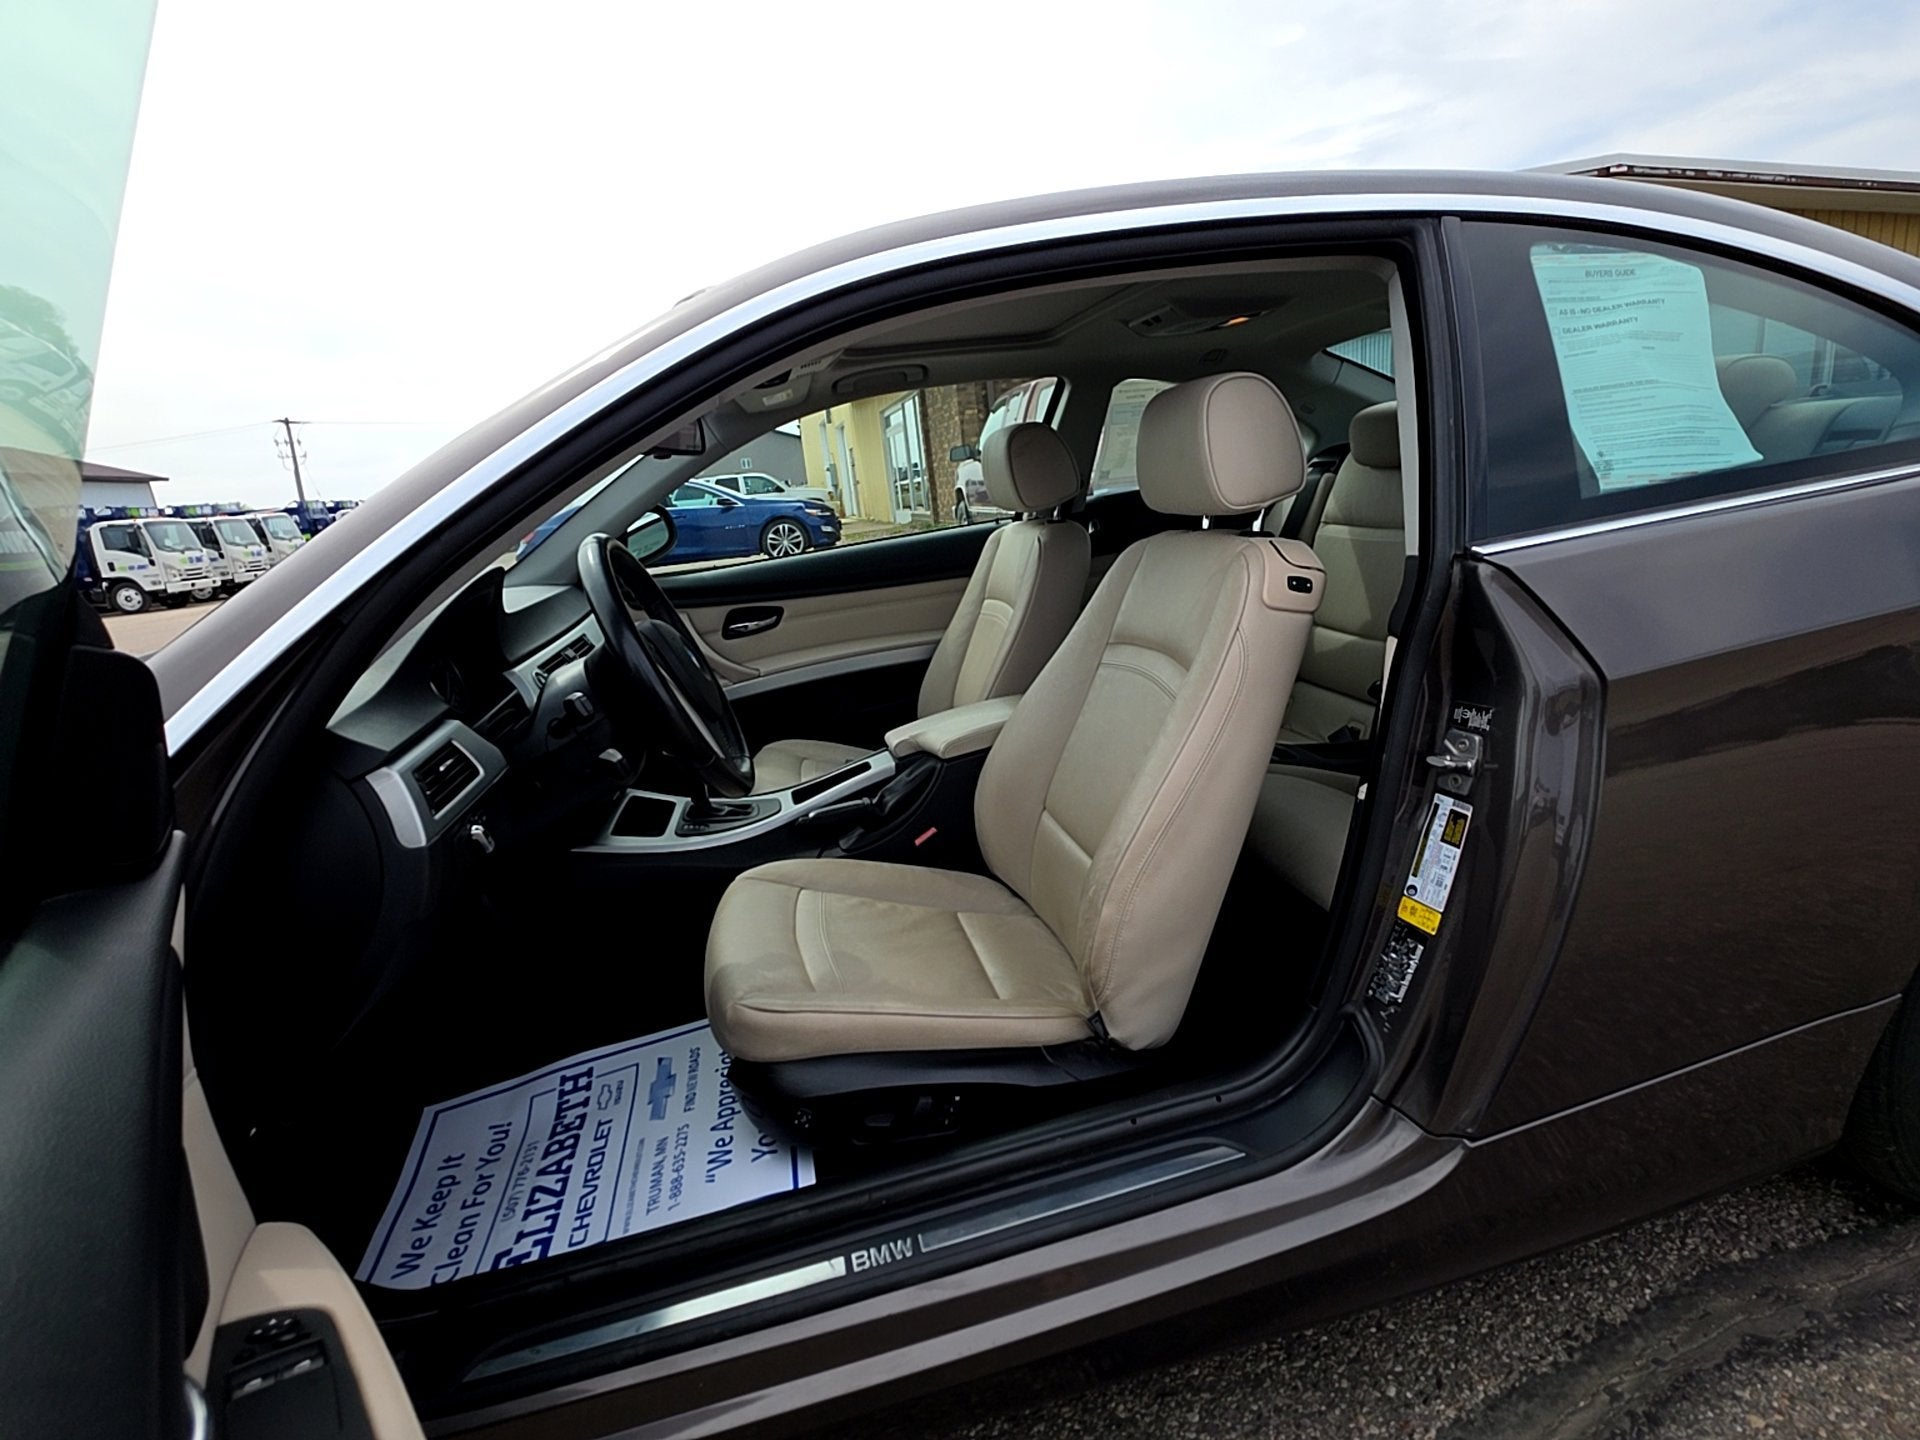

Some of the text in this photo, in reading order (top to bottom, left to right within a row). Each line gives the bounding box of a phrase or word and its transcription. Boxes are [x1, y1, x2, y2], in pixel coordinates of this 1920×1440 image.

[1562, 316, 1639, 335] DEALER WARRANTY
[1593, 303, 1623, 314] DEALER
[1624, 298, 1666, 308] WARRANTY
[490, 1066, 594, 1270] ELIZABETH
[568, 1118, 614, 1247] CHEVROLET
[751, 1130, 778, 1163] Yo
[390, 1153, 466, 1280] We Keep It
[430, 1122, 513, 1287] Clean For You!
[851, 1237, 913, 1273] BMW
